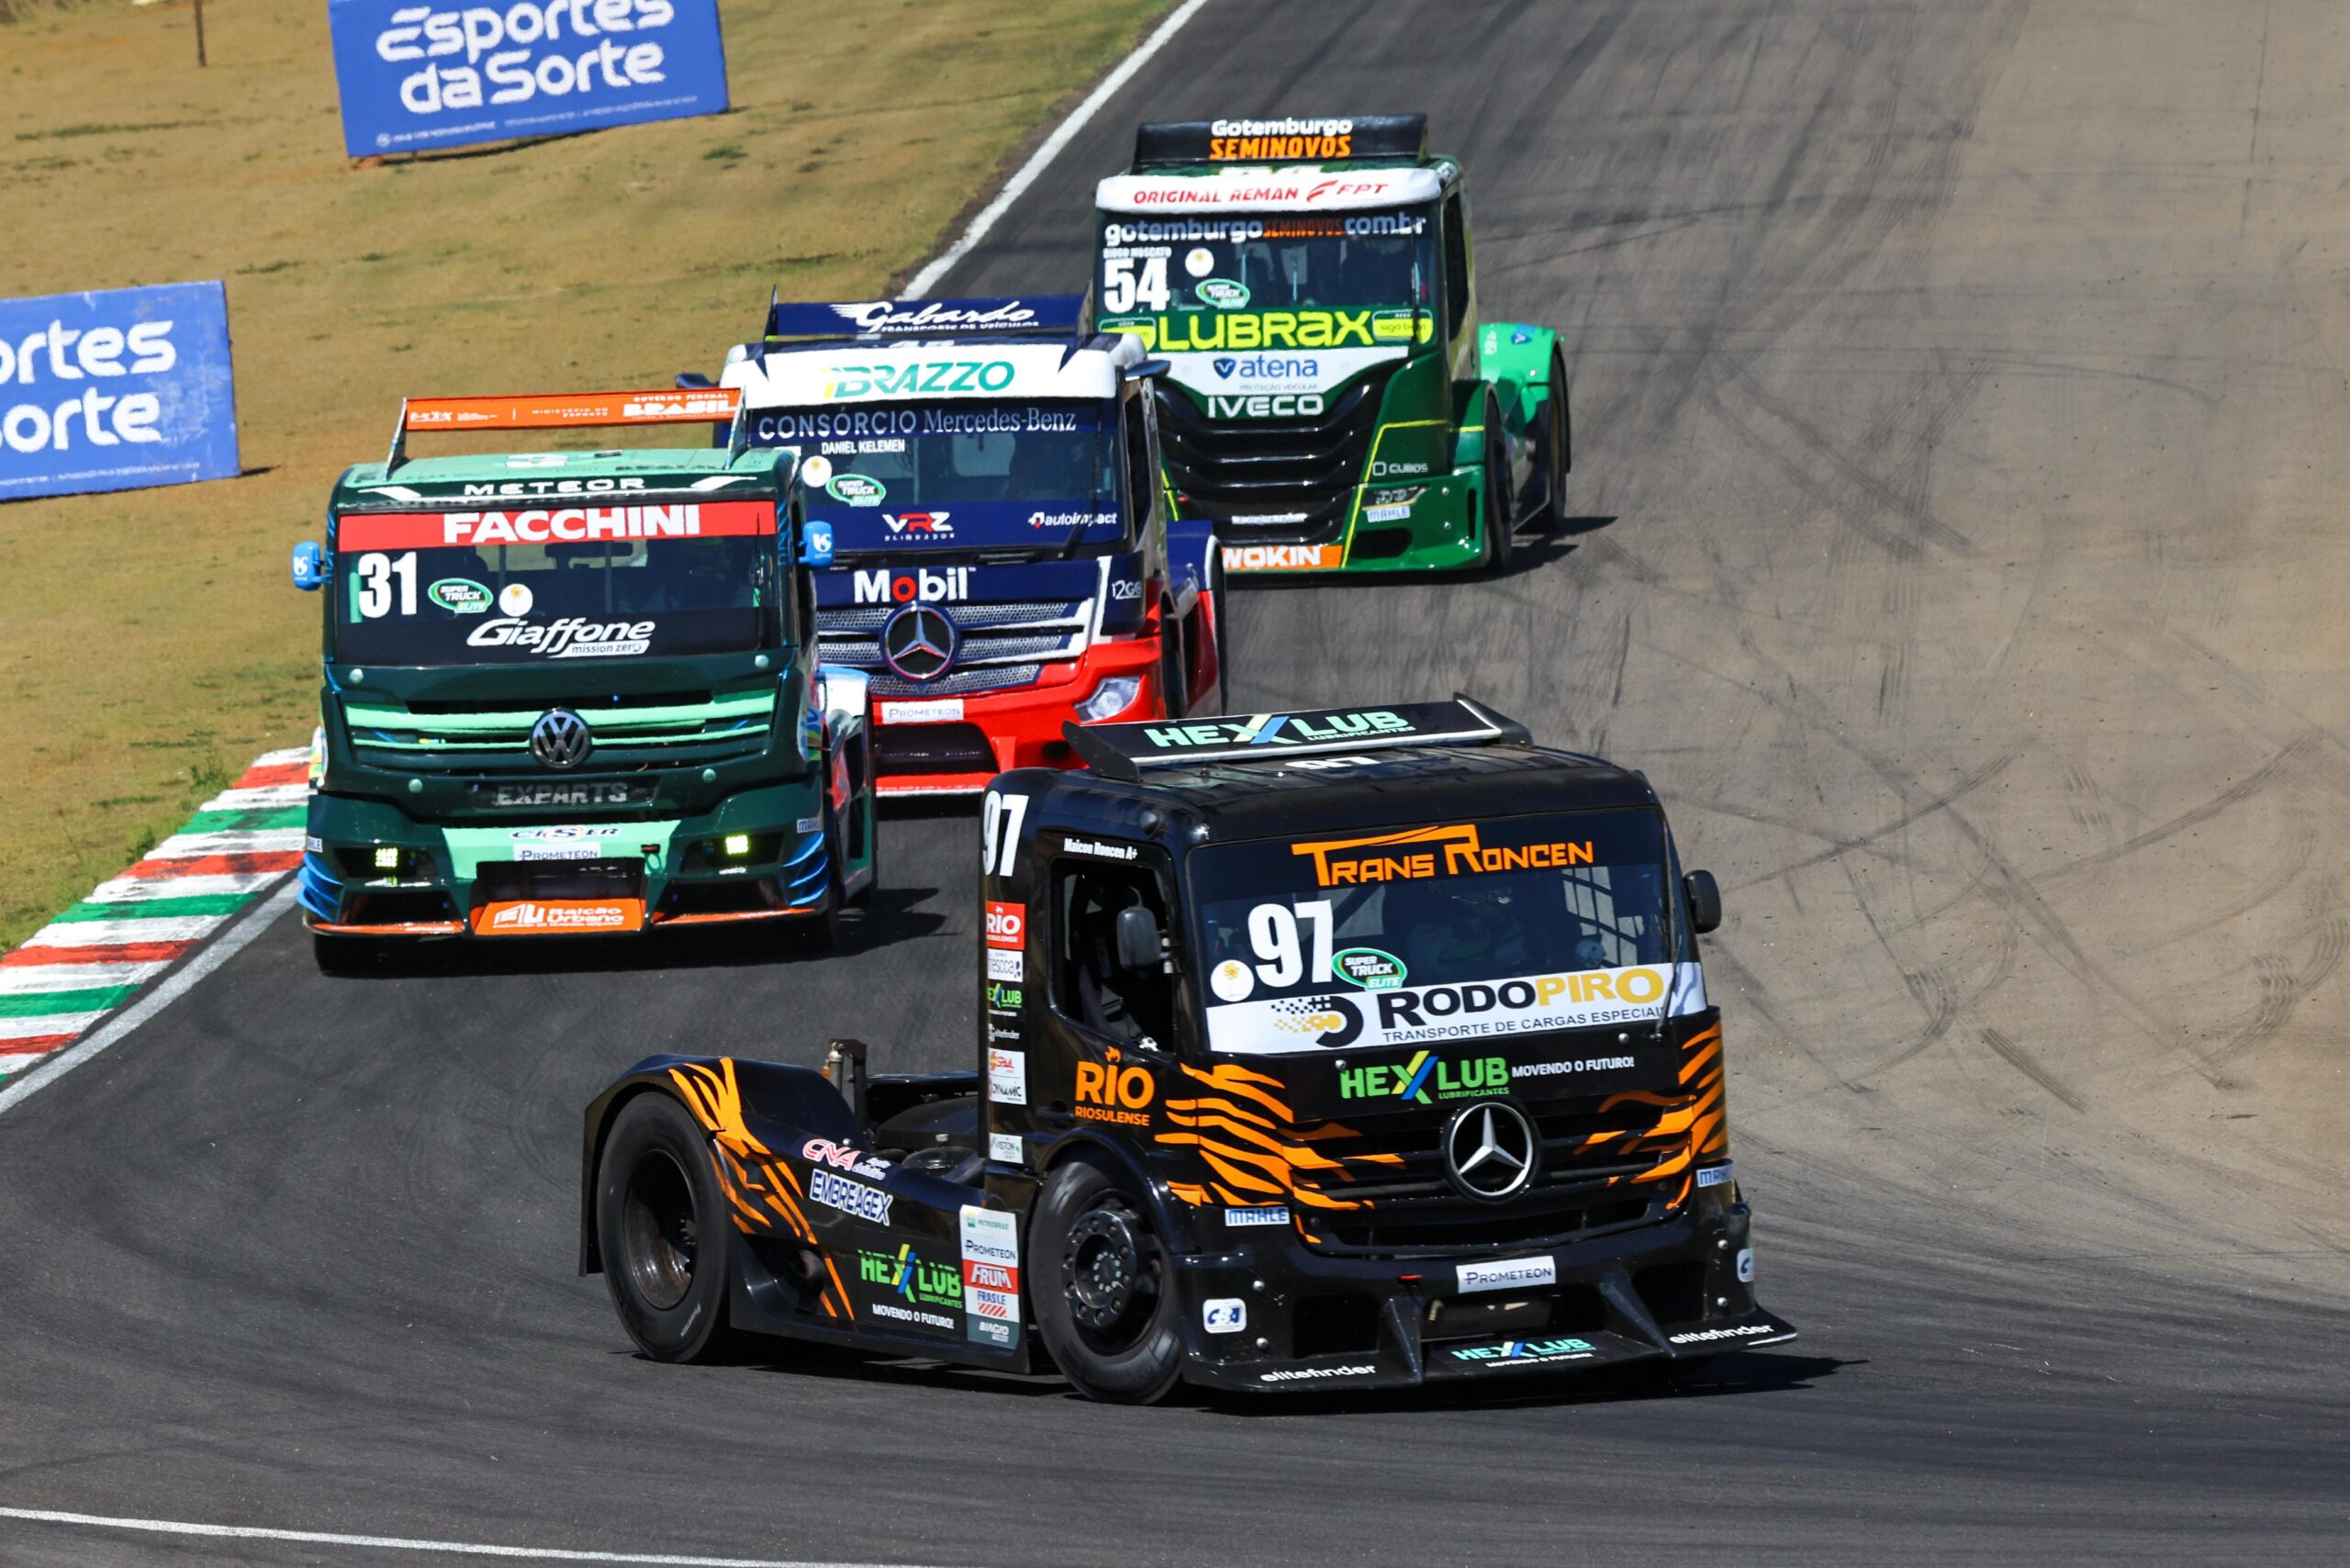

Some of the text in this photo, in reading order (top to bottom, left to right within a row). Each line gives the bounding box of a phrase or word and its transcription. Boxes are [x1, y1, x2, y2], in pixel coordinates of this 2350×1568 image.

[375, 0, 675, 64] Esportes
[1211, 117, 1353, 137] Gotemburgo
[1209, 135, 1352, 160] SEMINOVOS
[1134, 184, 1388, 204] ORIGINAL REMAN FPT
[1104, 258, 1171, 313] 54
[856, 300, 1035, 333] Gabardo
[1158, 309, 1375, 351] LUBRAX
[1239, 354, 1318, 378] atena
[828, 361, 1015, 398] BRAZZO
[623, 399, 736, 418] BRASIL
[1208, 394, 1325, 419] IVECO
[0, 386, 162, 454] orte
[758, 406, 1078, 441] CONSÓRCIO Mercedes-Benz
[821, 439, 906, 455] DANIEL KELEMEN
[464, 477, 645, 497] METEOR
[841, 485, 877, 496] TRUCK
[442, 504, 700, 543] FACCHINI
[882, 511, 954, 533] VRZ
[1045, 511, 1118, 527] autoimact
[1222, 545, 1322, 568] WOKIN
[358, 551, 418, 619] 31
[440, 584, 469, 593] SUPER
[445, 591, 482, 601] TRUCK
[853, 567, 969, 603] Mobil
[466, 617, 655, 654] Giaffone
[571, 642, 614, 655] mission
[889, 708, 960, 718] PROMETEON
[512, 826, 621, 838] CISER
[982, 790, 1029, 877] 97
[519, 849, 599, 860] PROMETEON
[1291, 825, 1594, 887] TRANS RONCEN
[547, 913, 625, 924] Urbano
[986, 907, 1022, 935] RIO
[1247, 900, 1335, 989] 97
[1344, 955, 1378, 967] SUPER
[1350, 962, 1394, 977] TRUCK
[1367, 977, 1404, 989] ELITE
[1377, 967, 1665, 1030] RODOPIRO
[1382, 1004, 1669, 1043] TRANSPORTE DE CARGAS ESPECIAI
[1075, 1048, 1156, 1109] RIO
[1512, 1056, 1635, 1078] MOVENDO O FUTURO!
[1438, 1087, 1510, 1100] LUBRIFICANTES
[1075, 1105, 1151, 1126] RIOSULENSE
[802, 1138, 861, 1171] CNA
[810, 1169, 894, 1226] EMBREAGEX
[1228, 1208, 1289, 1224] MAHLE
[964, 1239, 1017, 1260] PROMETEON
[971, 1263, 1013, 1290] FRUM
[1462, 1266, 1553, 1284] PROMETEON
[872, 1304, 955, 1329] MOVENDO O FUTURO!
[1669, 1322, 1775, 1345] elitefinder
[1260, 1364, 1377, 1382] elitefinder
